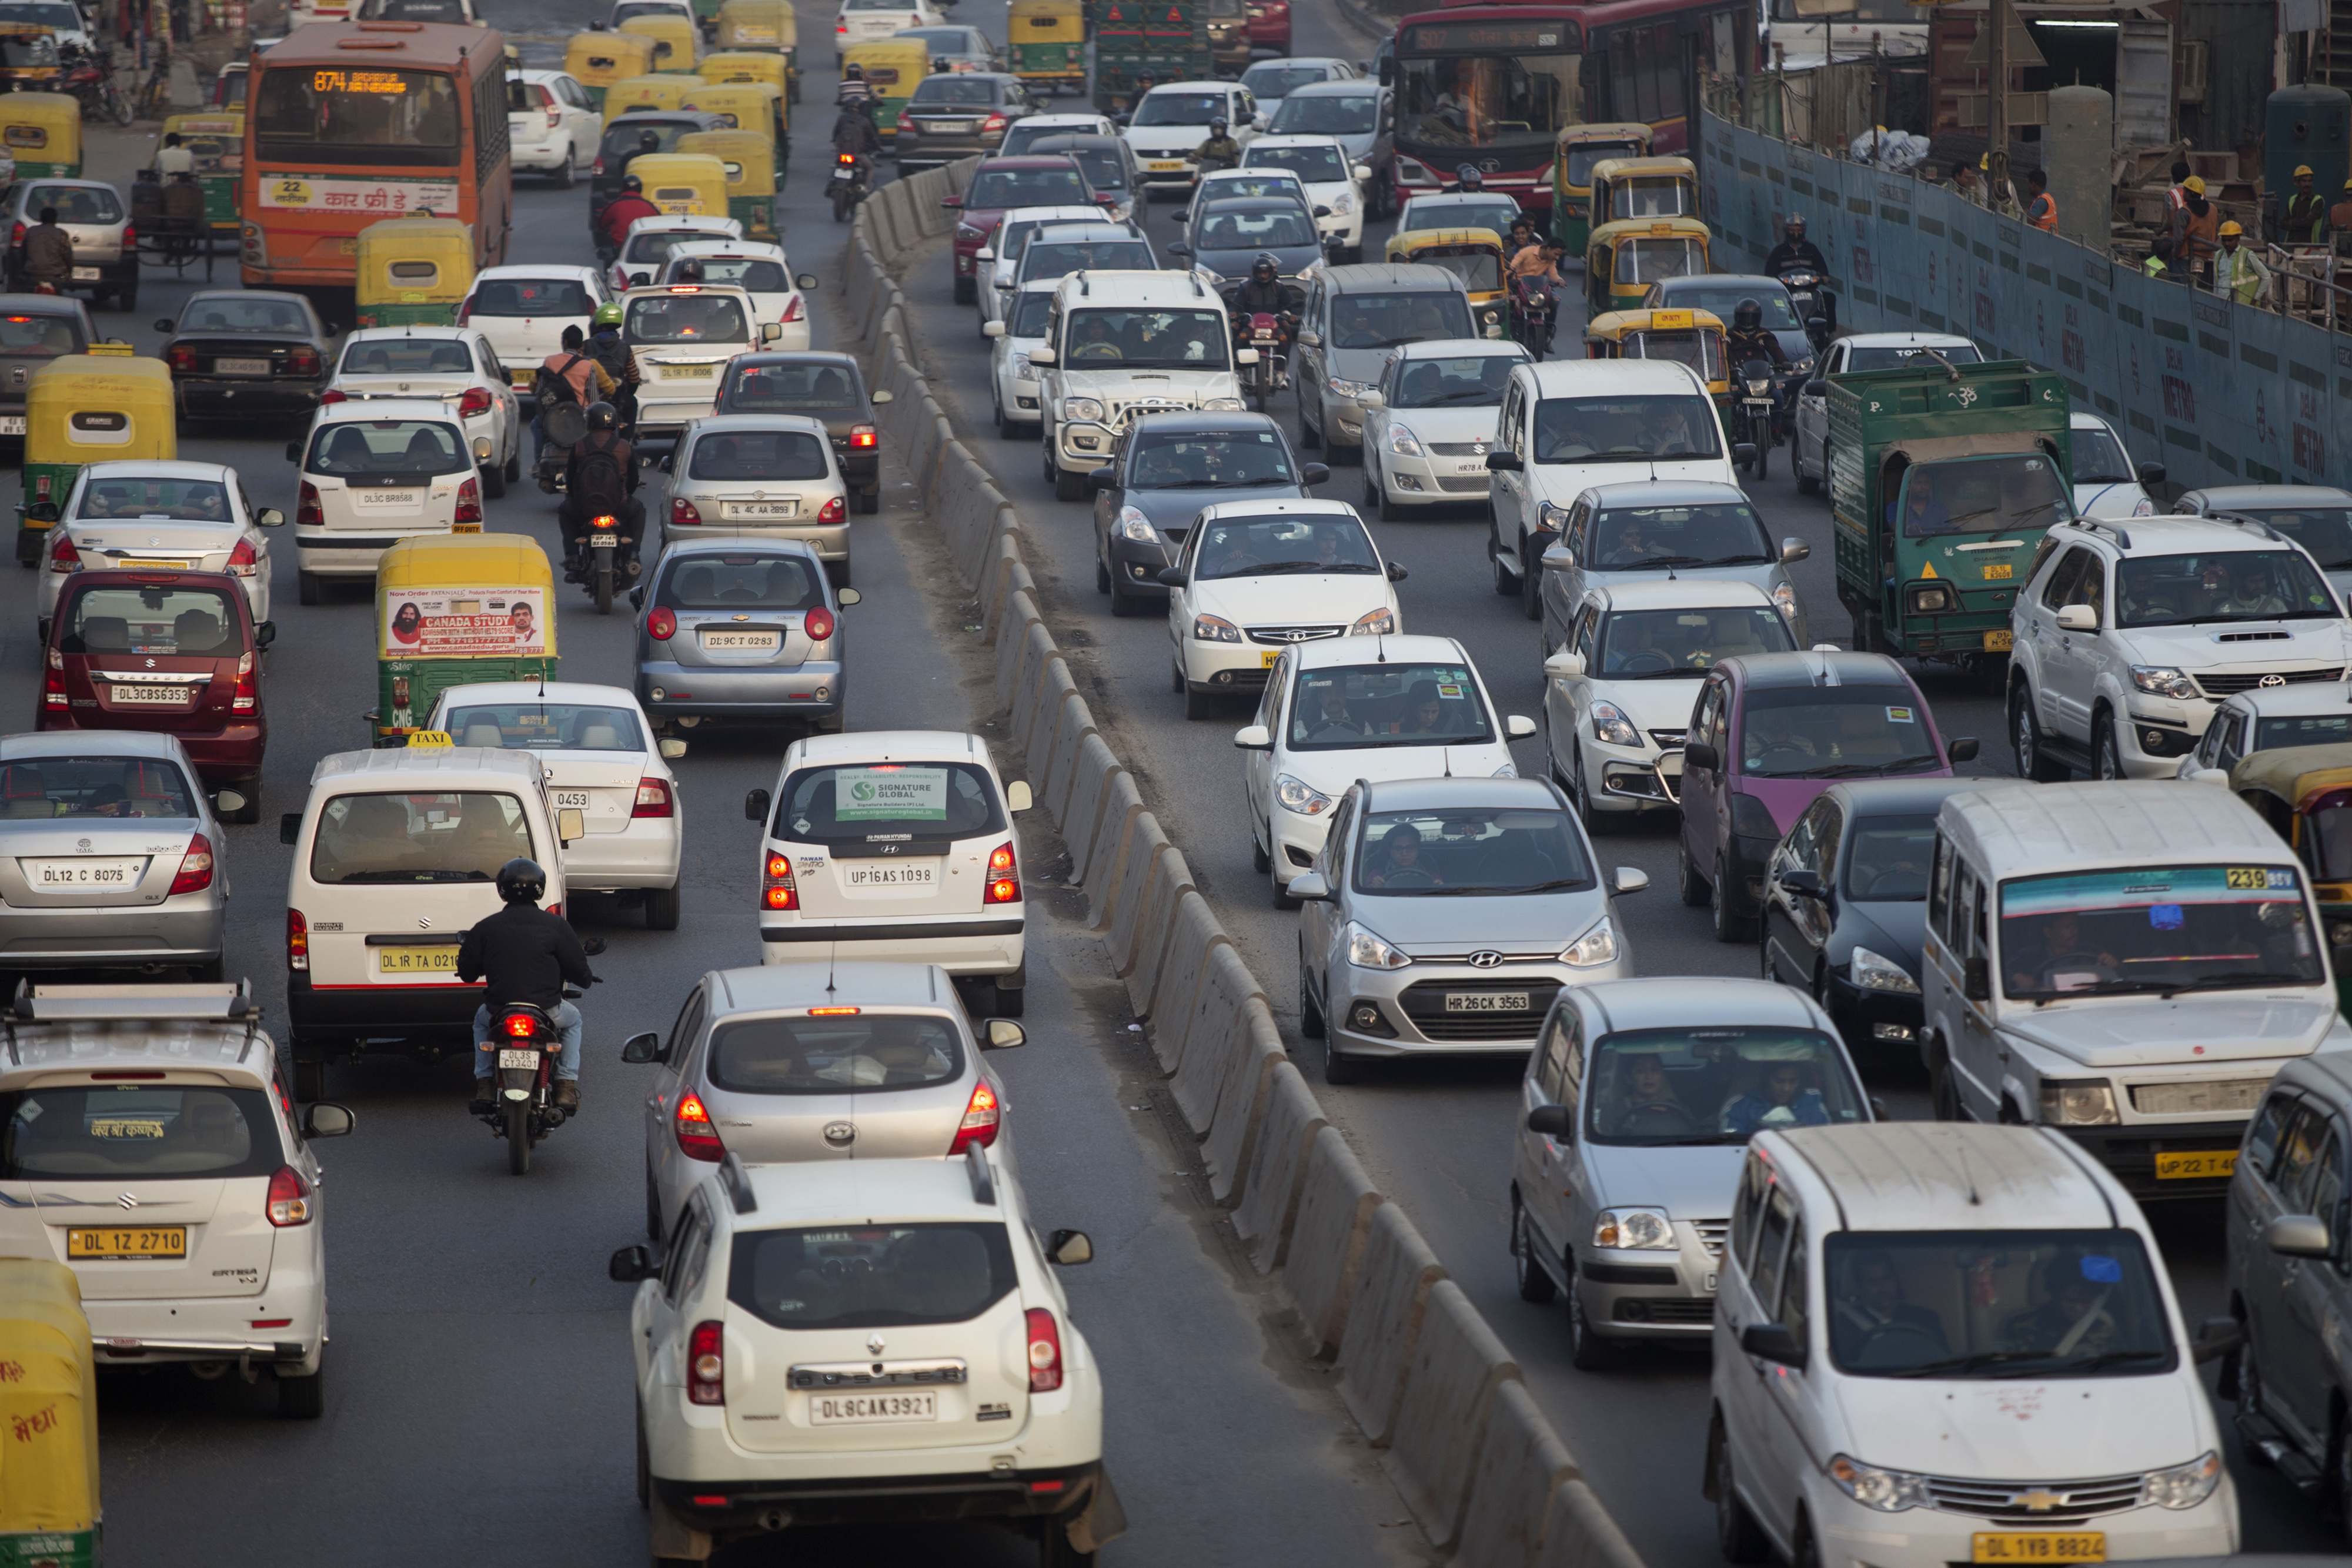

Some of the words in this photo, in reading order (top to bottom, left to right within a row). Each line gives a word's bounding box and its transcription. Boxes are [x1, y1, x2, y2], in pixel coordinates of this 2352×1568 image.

[1419, 30, 1447, 49] 507
[315, 71, 346, 91] 874
[283, 182, 300, 192] 22
[325, 193, 358, 207] कार
[364, 188, 386, 208] फ्री
[393, 189, 406, 210] डे
[272, 256, 303, 265] TATA
[2061, 325, 2086, 375] METRO
[2165, 346, 2183, 372] DELHI
[693, 368, 711, 376] 8006
[2161, 374, 2196, 424] METRO
[2300, 392, 2317, 423] DELHI
[2293, 422, 2325, 479] METRO
[385, 494, 413, 503] BR8588
[770, 506, 789, 514] 2893
[426, 617, 471, 627] CANADA
[474, 617, 510, 626] STUDY
[723, 637, 735, 645] 9C
[738, 637, 744, 645] T
[1265, 656, 1277, 666] H
[119, 688, 188, 700] DL3CBS6353
[392, 709, 412, 727] CNG
[415, 734, 445, 743] TAXI
[558, 794, 586, 805] 0453
[45, 871, 72, 881] DL12
[80, 870, 86, 881] C
[95, 870, 123, 881] 8075
[900, 870, 931, 882] 1098
[2230, 871, 2266, 888] 239
[383, 955, 396, 967] DL
[400, 955, 410, 967] 1R
[416, 955, 429, 967] TA
[1499, 997, 1527, 1008] 3563
[509, 1051, 530, 1059] DL3S
[505, 1059, 536, 1068] CY3401
[91, 1124, 109, 1137] जय
[111, 1121, 125, 1137] श्री
[2160, 1161, 2180, 1174] UP
[2183, 1160, 2201, 1172] 22
[2207, 1159, 2216, 1171] T
[85, 1233, 104, 1250] DL
[114, 1233, 131, 1250] 1Z
[141, 1233, 180, 1250] 2710
[212, 1268, 258, 1276] ERTIGA
[796, 1370, 959, 1386] DUSTER
[822, 1398, 933, 1419] DL8CAK3921
[1987, 1539, 2011, 1557] DL
[2056, 1538, 2103, 1556] 8824
